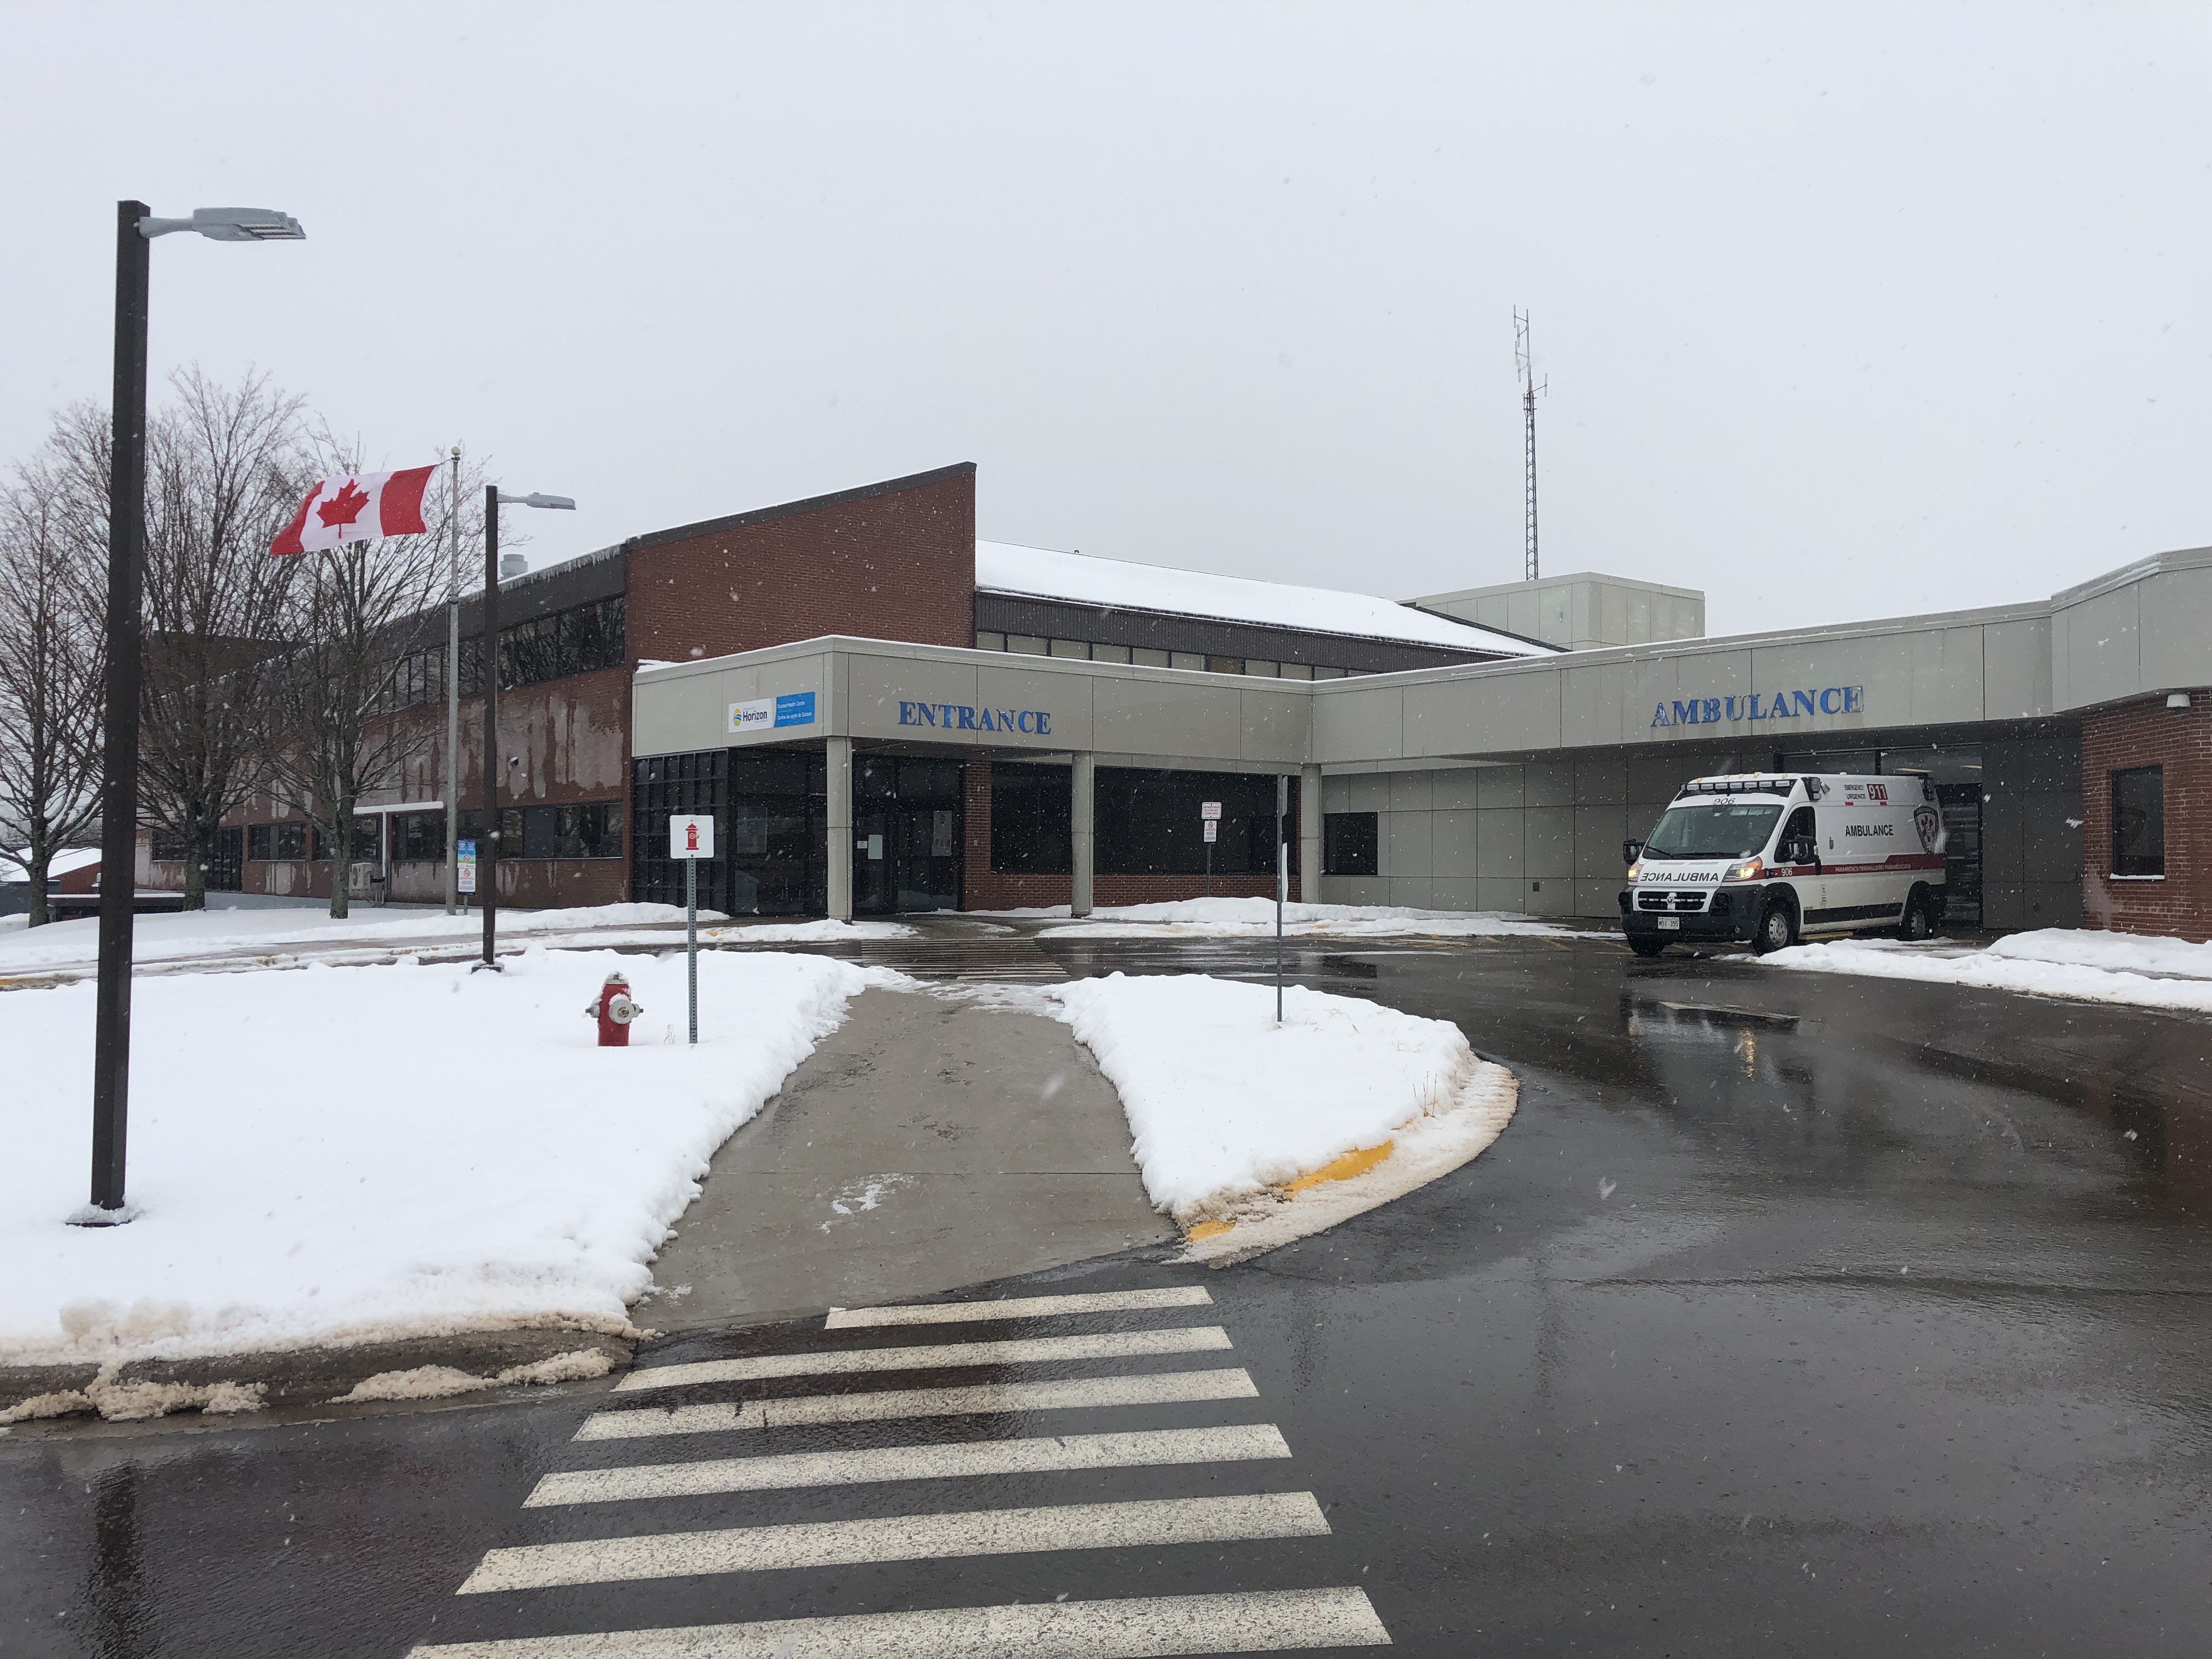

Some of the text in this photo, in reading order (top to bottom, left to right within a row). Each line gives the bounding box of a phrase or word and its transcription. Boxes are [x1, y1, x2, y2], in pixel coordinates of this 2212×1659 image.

[1650, 686, 1864, 727] AMBULANCE
[743, 710, 768, 721] Horizon
[898, 701, 1051, 735] ENTRANCE
[1869, 785, 1887, 799] 911
[1845, 824, 1894, 837] AMBULANCE
[1781, 867, 1793, 876] 906
